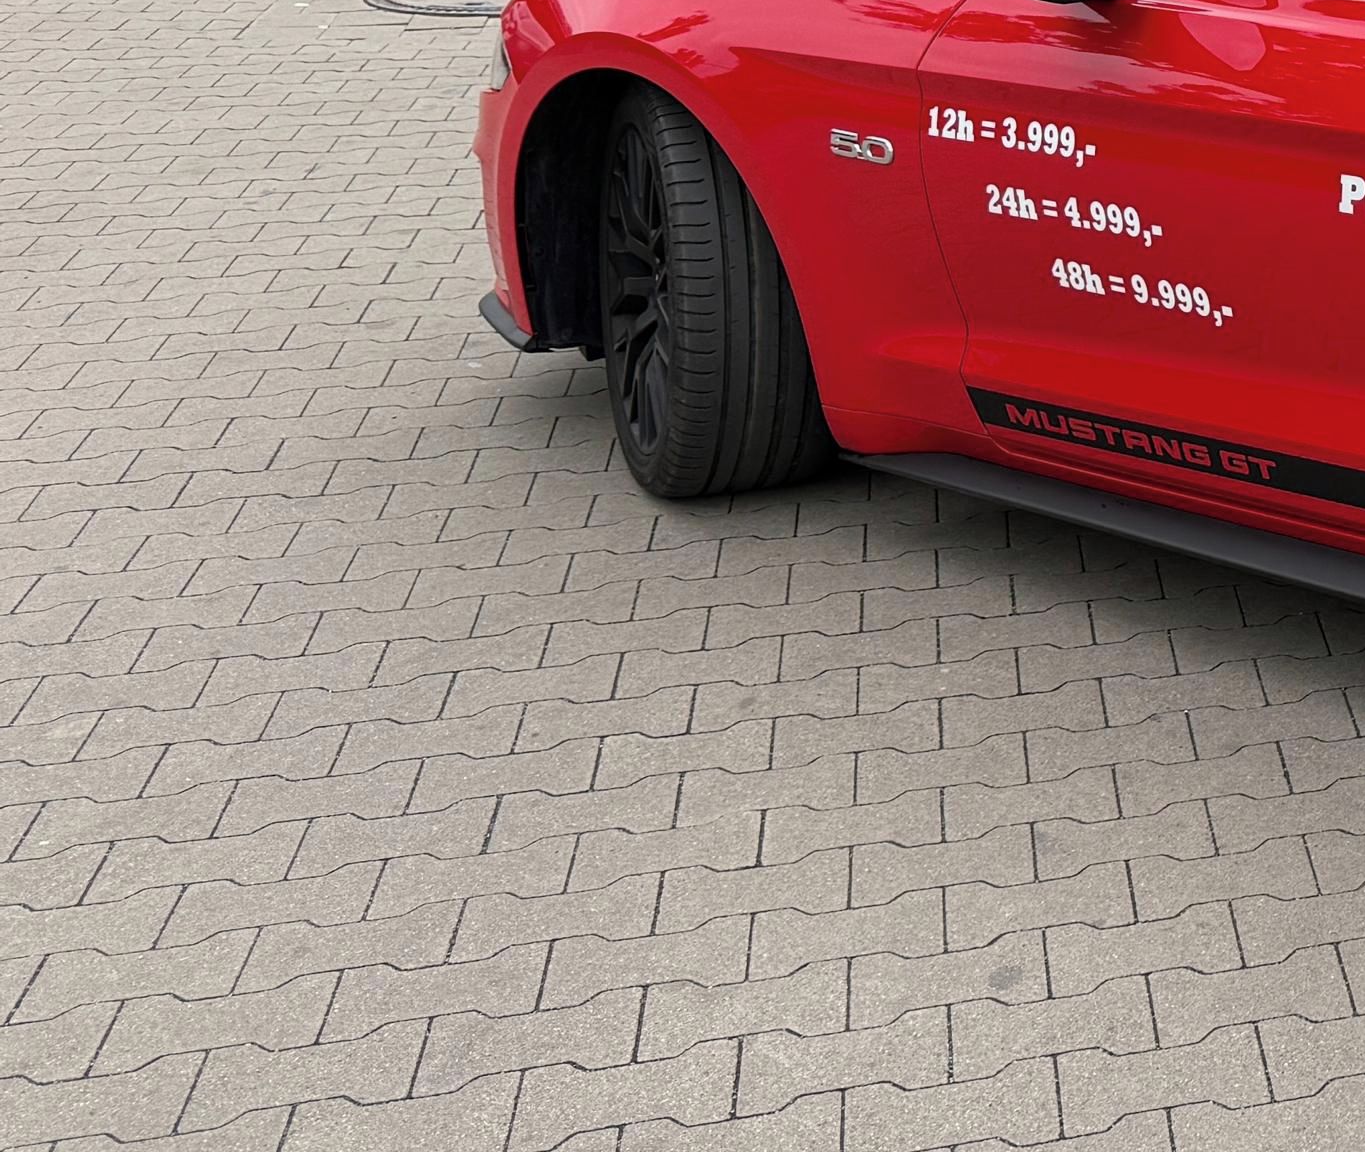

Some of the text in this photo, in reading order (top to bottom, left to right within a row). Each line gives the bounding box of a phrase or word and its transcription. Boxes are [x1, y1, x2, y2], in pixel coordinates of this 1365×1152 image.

[928, 106, 975, 142] 12h
[1001, 116, 1097, 167] 3.999,-
[986, 183, 1038, 221] 24h
[1064, 196, 1163, 247] 4.999,-
[1051, 258, 1106, 295] 48h
[1130, 273, 1234, 326] 9.999,-
[1005, 403, 1277, 480] MUSTANG GT
